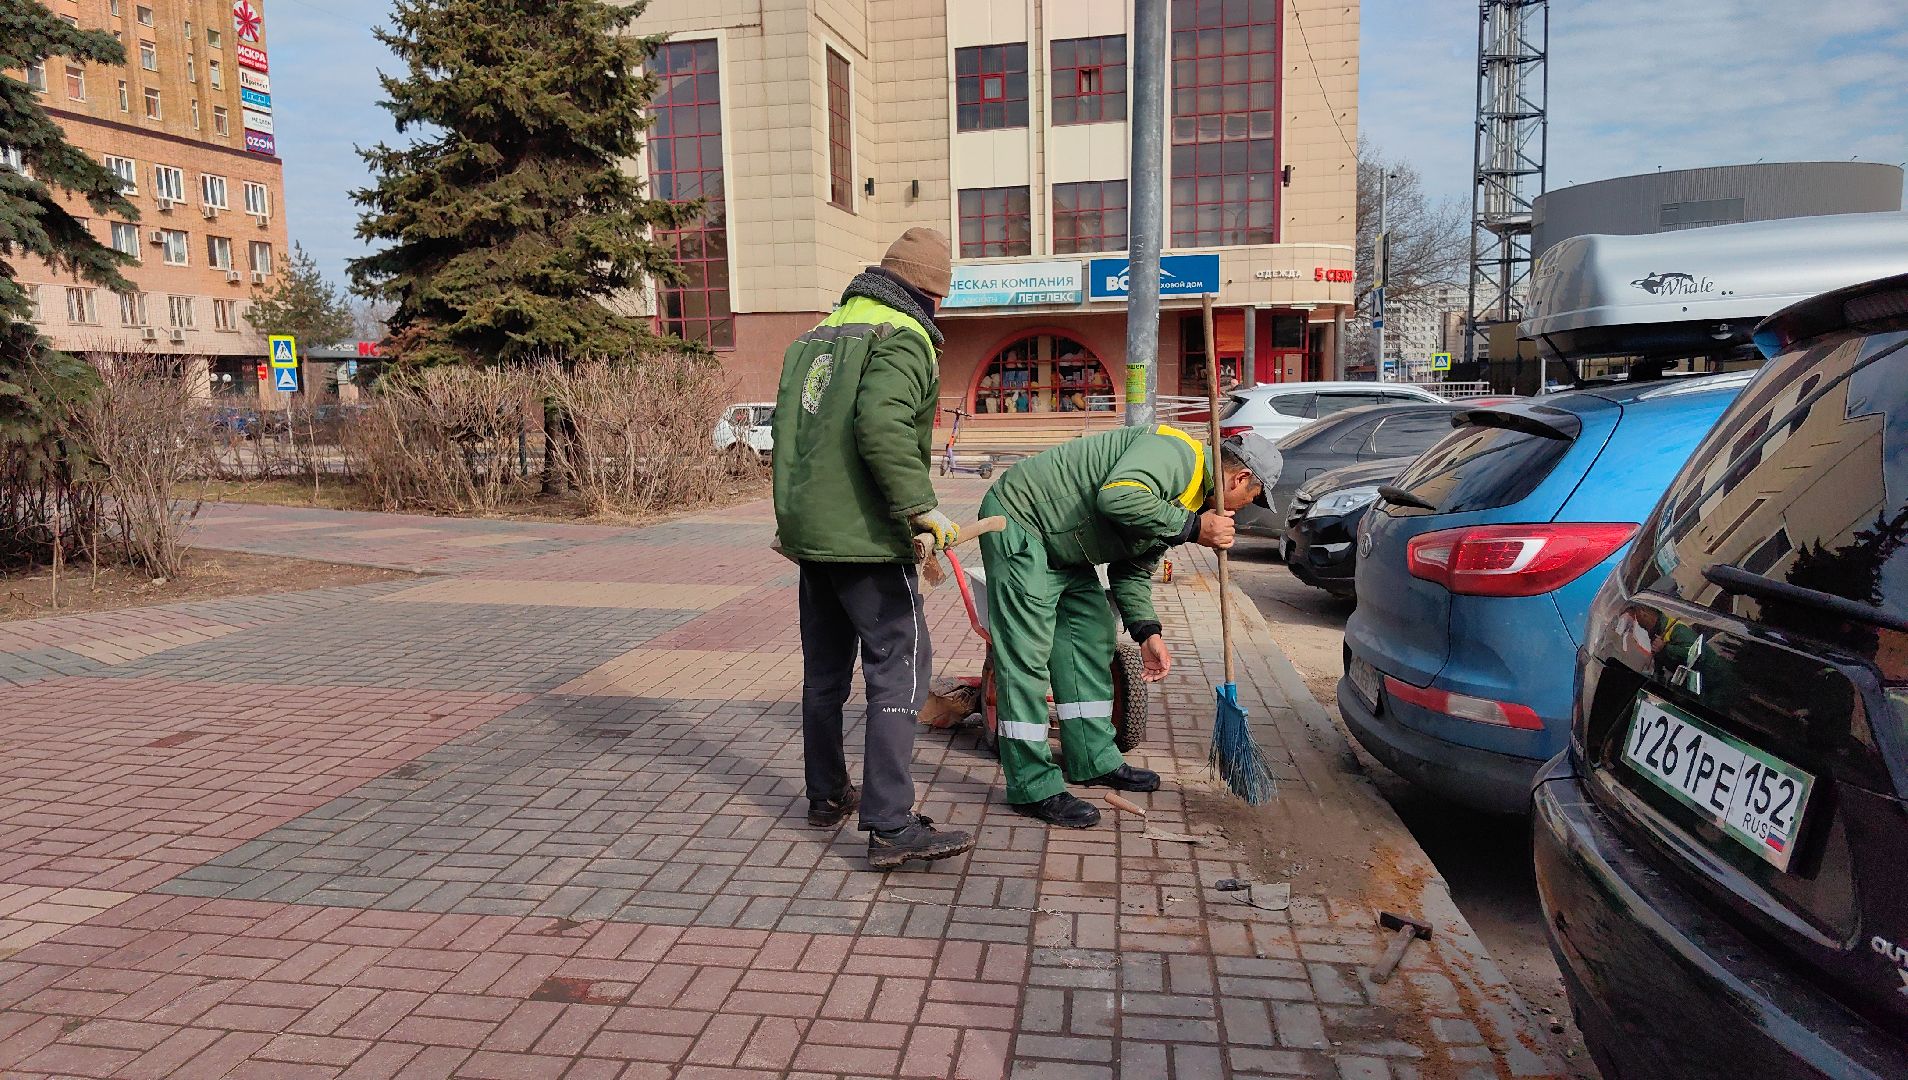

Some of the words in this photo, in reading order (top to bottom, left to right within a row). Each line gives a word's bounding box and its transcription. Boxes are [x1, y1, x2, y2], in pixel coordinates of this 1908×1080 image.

[237, 45, 267, 63] ИСКРА
[247, 136, 273, 150] OZON
[1255, 269, 1302, 279] ОДЕЖДА
[1314, 266, 1323, 282] 5
[1001, 275, 1074, 289] КОМПАНИЯ
[1186, 281, 1203, 289] ДОМ
[1661, 275, 1715, 296] Whale
[1017, 291, 1074, 304] ЛЕГЕЛЕКС
[1745, 762, 1795, 828] 152
[1742, 812, 1769, 840] RUS
